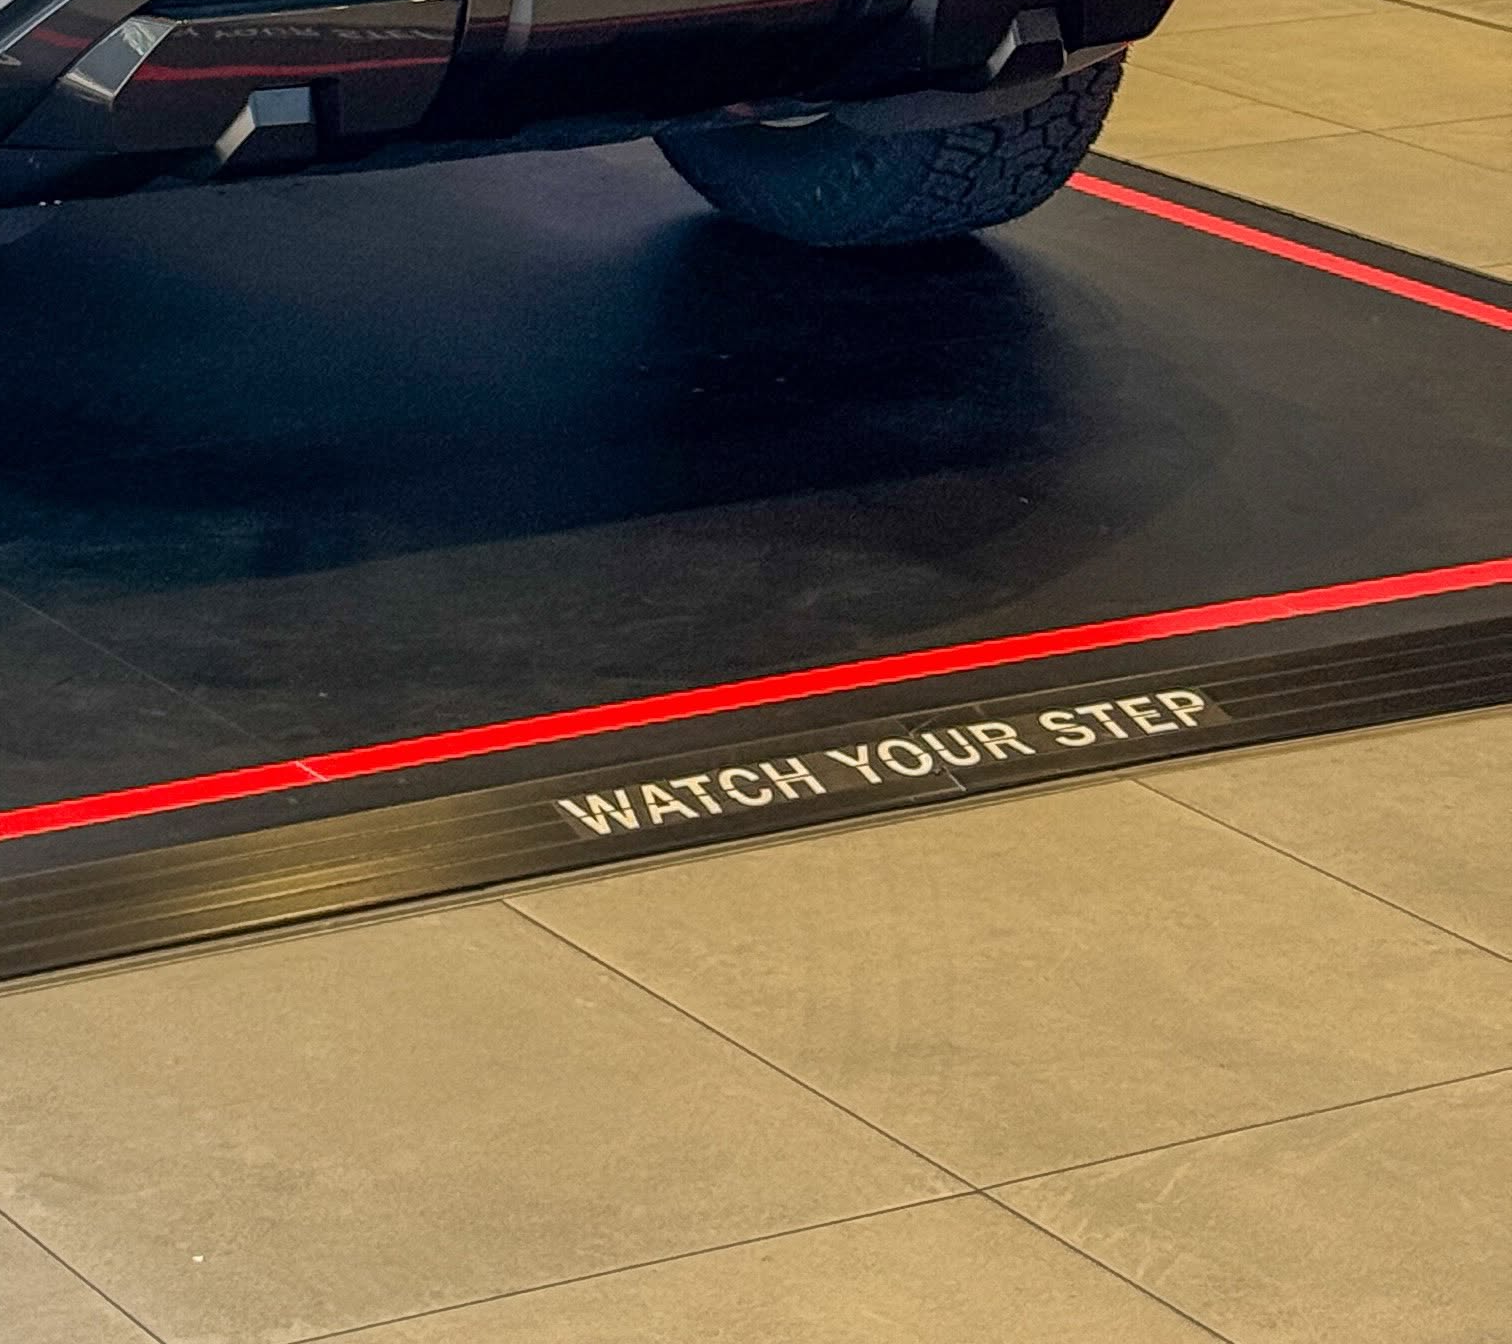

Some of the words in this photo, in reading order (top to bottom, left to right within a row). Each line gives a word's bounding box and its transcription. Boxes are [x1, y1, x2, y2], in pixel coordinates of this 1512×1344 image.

[557, 756, 827, 837] WATCH
[826, 720, 1035, 785] YOUR
[1038, 688, 1206, 748] STEP
